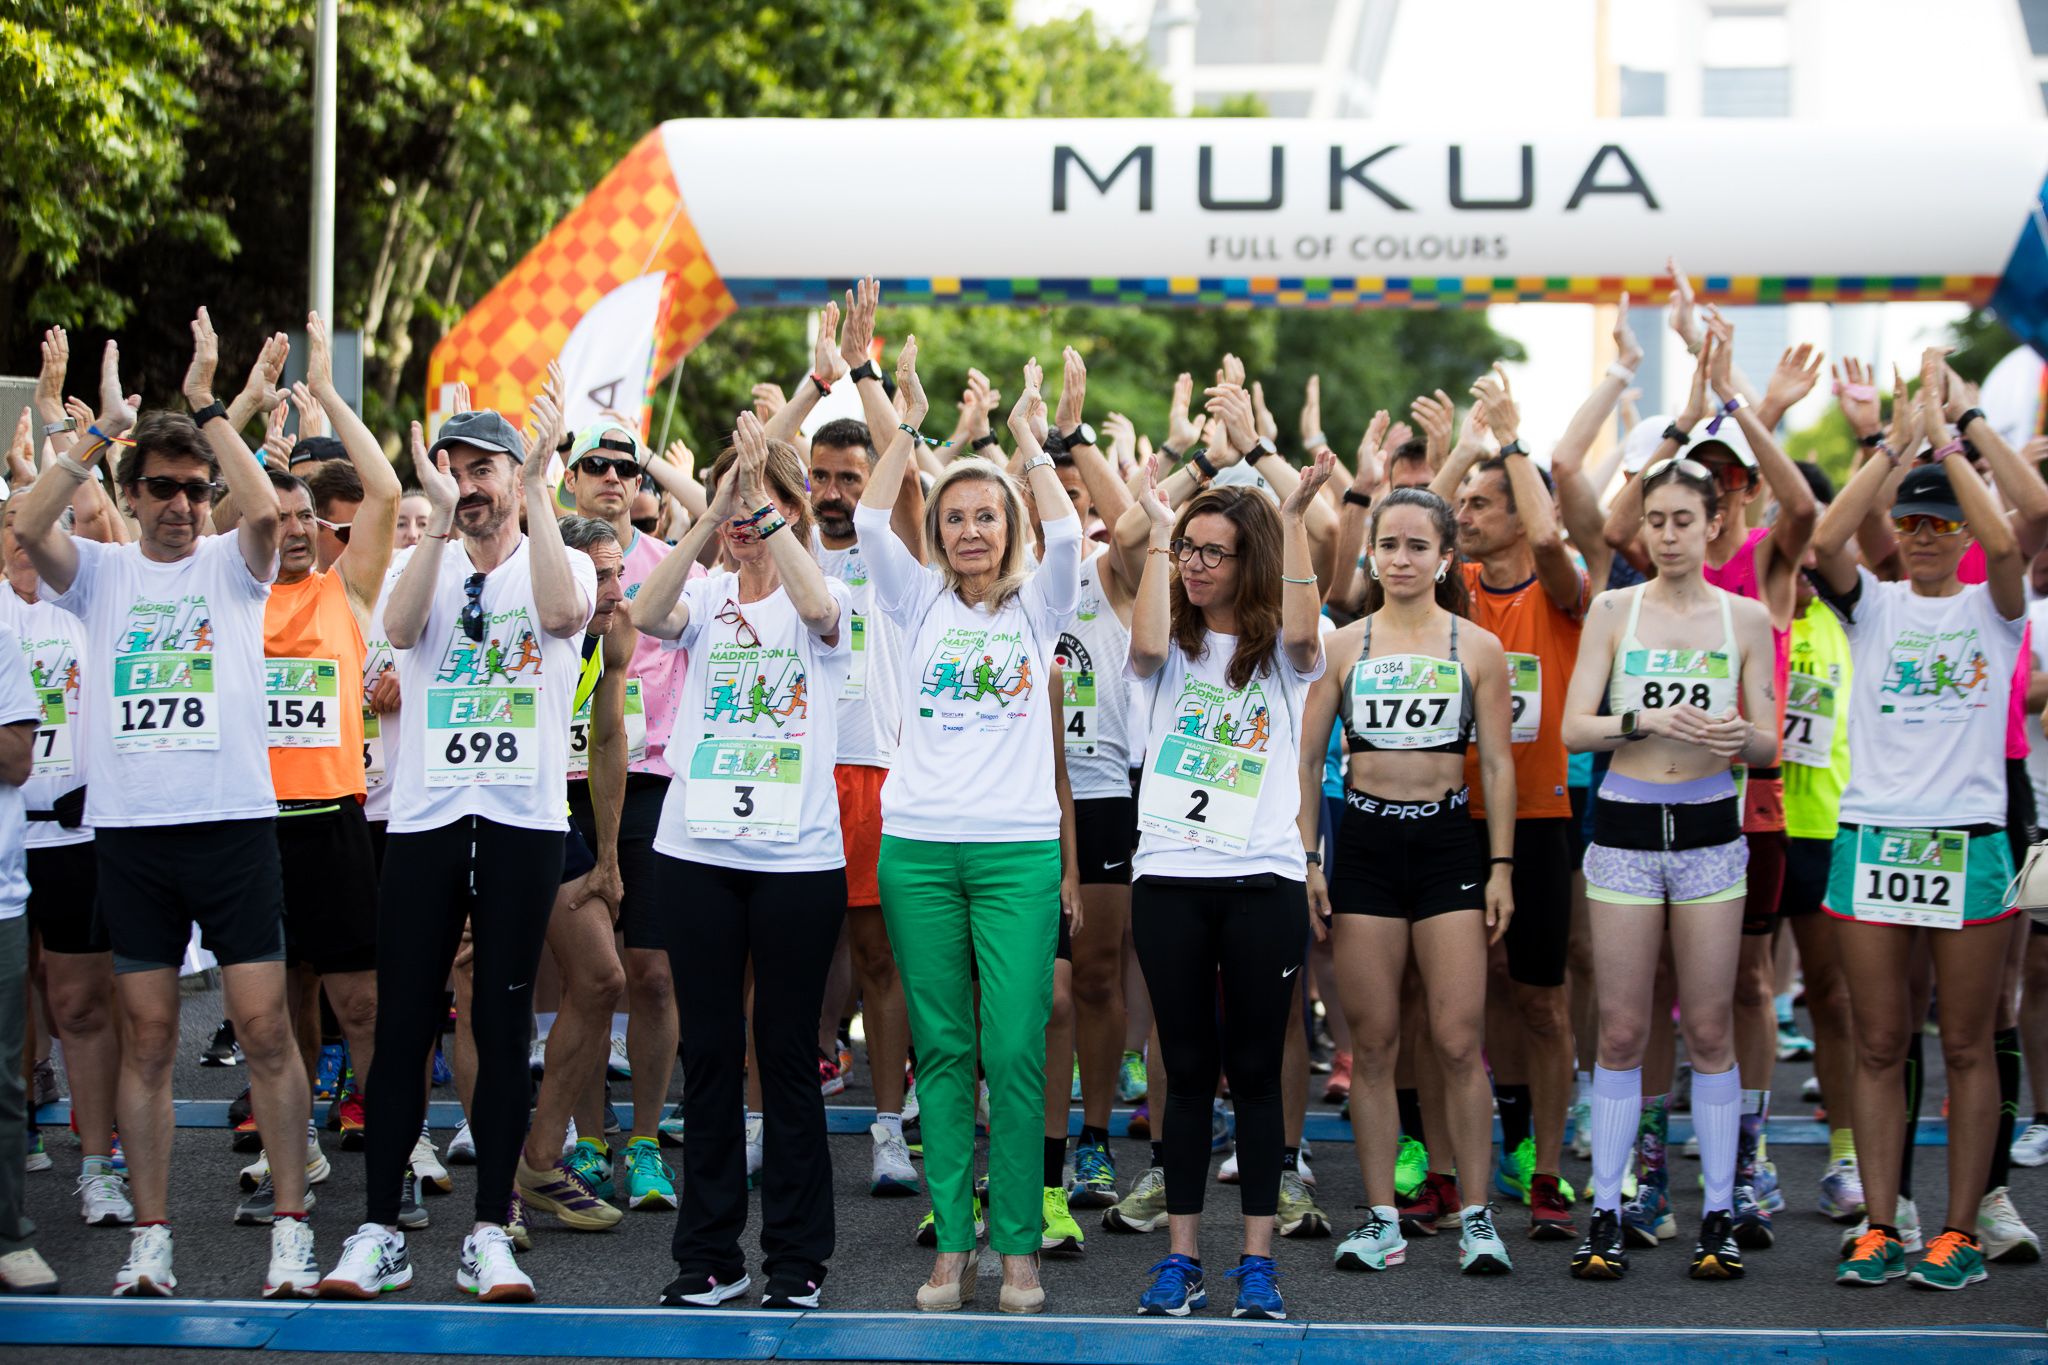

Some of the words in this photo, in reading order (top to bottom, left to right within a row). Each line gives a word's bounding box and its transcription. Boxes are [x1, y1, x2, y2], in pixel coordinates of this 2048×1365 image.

[1053, 145, 1661, 212] MUKUA
[1208, 236, 1279, 261] FULL
[1294, 236, 1335, 261] OF
[1351, 236, 1508, 261] COLOURS
[709, 651, 759, 660] MADRID
[1374, 661, 1404, 675] 0384
[1645, 649, 1709, 674] ELA
[128, 662, 192, 690] ELA
[448, 697, 513, 724] ELA
[1642, 681, 1711, 711] 828
[121, 697, 205, 732] 1278
[268, 699, 326, 728] 154
[1067, 711, 1086, 738] 4
[1365, 698, 1450, 729] 1767
[445, 731, 519, 764] 698
[711, 748, 777, 778] ELA
[1175, 748, 1238, 788] ELA
[733, 786, 755, 817] 3
[1185, 789, 1210, 824] 2
[1381, 802, 1440, 820] PRO
[1879, 836, 1943, 867] ELA
[1867, 868, 1950, 907] 1012
